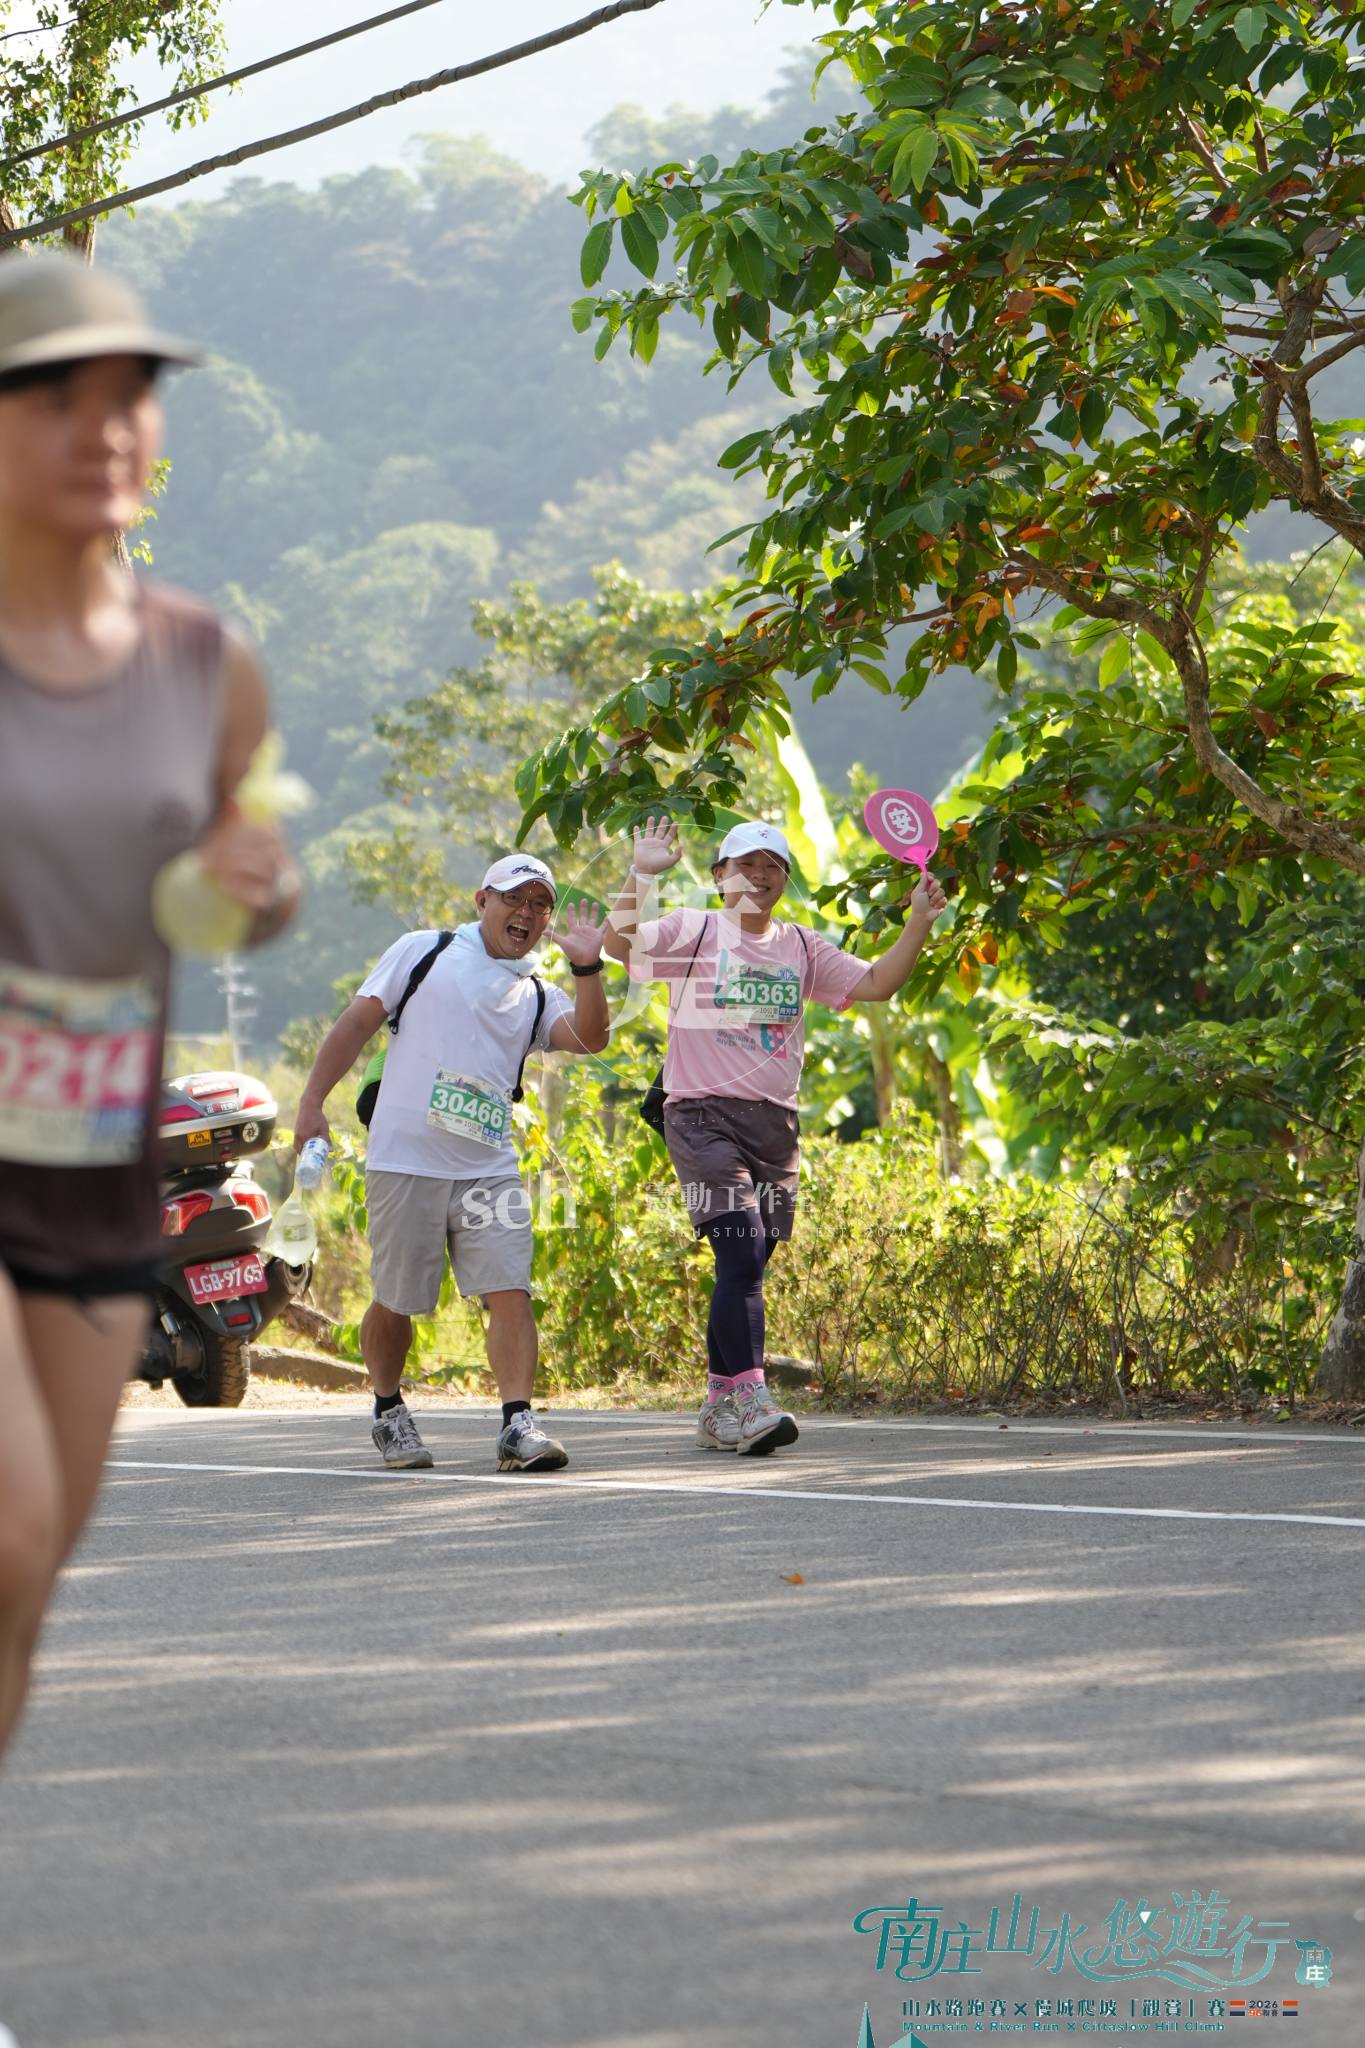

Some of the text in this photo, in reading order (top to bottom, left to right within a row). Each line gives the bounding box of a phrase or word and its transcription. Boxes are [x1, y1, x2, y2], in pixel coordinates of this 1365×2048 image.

[888, 807, 917, 837] 安
[728, 981, 798, 1006] 40363
[432, 1087, 504, 1129] 30466
